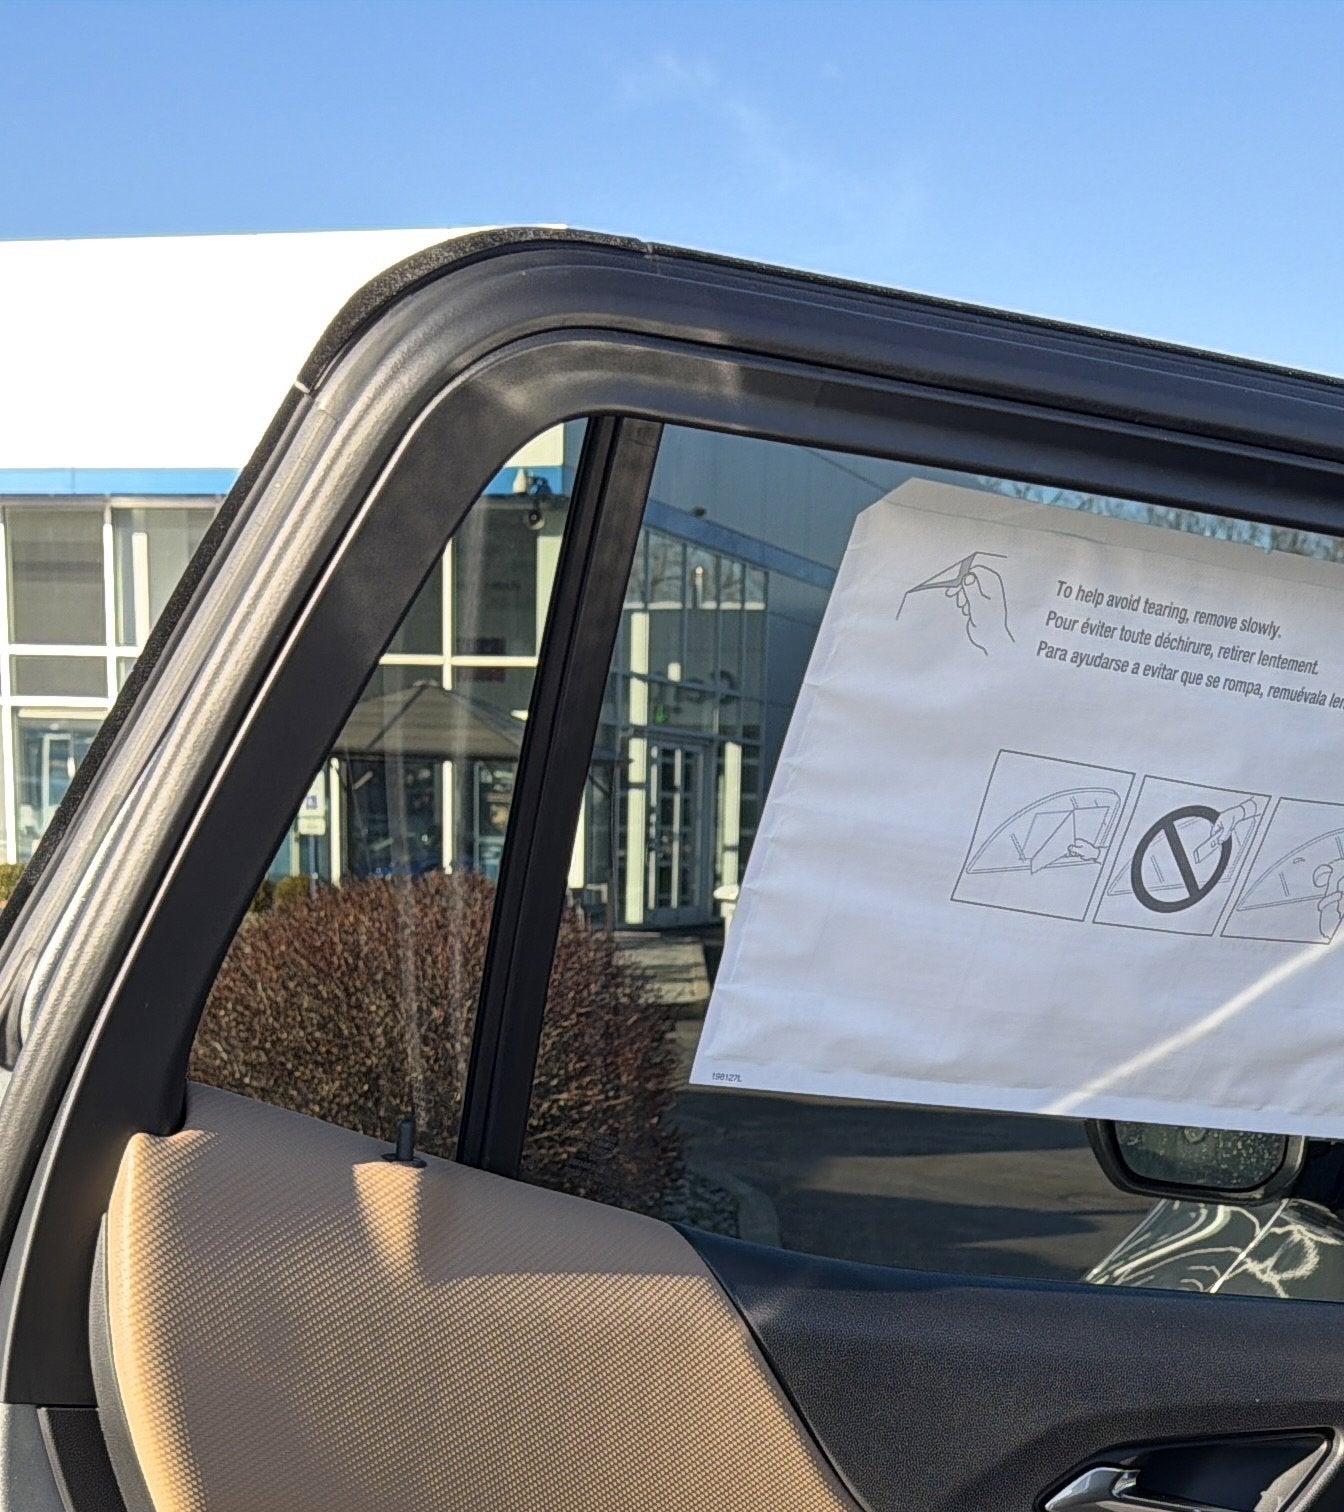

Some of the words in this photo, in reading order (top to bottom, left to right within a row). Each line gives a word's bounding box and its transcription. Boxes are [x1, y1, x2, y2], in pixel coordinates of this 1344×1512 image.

[1045, 610, 1079, 632] Pour
[1080, 617, 1118, 640] éviter
[1119, 625, 1152, 646] toute
[1154, 632, 1214, 660] déchirure,
[1217, 645, 1256, 664] retirer
[1257, 650, 1319, 675] lentement.
[1056, 580, 1072, 598] To
[1075, 584, 1104, 608] help
[1106, 593, 1141, 612] avoid
[1142, 598, 1190, 624] tearing,
[1193, 610, 1238, 630] remove
[1239, 616, 1282, 640] slowly.
[1036, 640, 1068, 662] Para
[1070, 650, 1129, 673] ayudarse
[1131, 661, 1141, 675] a
[1142, 662, 1179, 681] evitar
[1180, 670, 1203, 687] que
[1205, 675, 1221, 689] se
[1222, 677, 1264, 698] rompa,
[1266, 686, 1327, 706] remuévala
